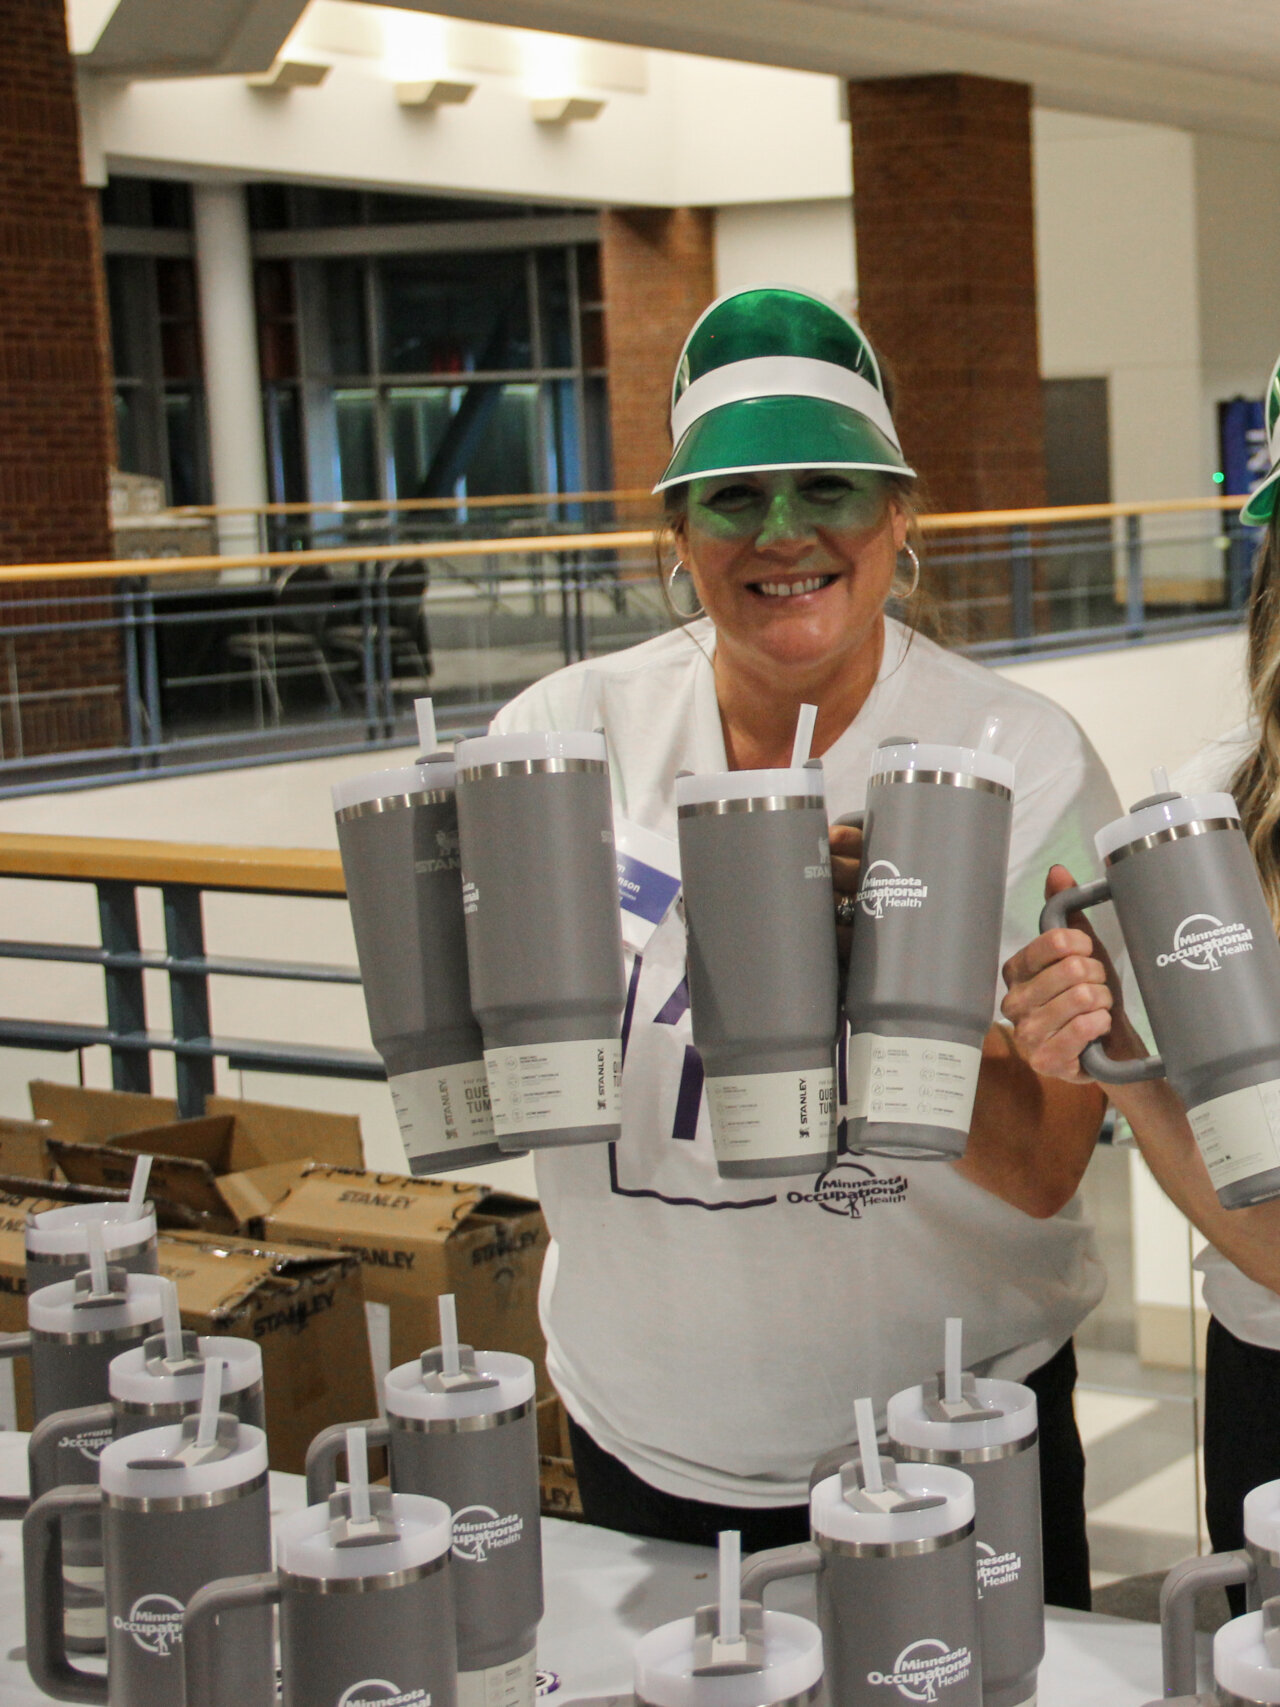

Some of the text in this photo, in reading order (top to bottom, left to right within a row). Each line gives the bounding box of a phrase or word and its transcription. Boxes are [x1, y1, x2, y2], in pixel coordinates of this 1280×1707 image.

[414, 857, 461, 874] STAN
[617, 877, 641, 893] nson
[864, 877, 922, 889] Minnesota
[885, 896, 922, 908] Health
[1179, 922, 1245, 947] Minnesota
[1156, 928, 1253, 967] Occupational
[1217, 941, 1253, 957] Health
[598, 1048, 606, 1096] STANLEY
[799, 1077, 808, 1125] STANLEY
[786, 1178, 908, 1204] Occupational
[821, 1175, 902, 1190] Minnesota
[863, 1194, 906, 1207] Health
[453, 1513, 519, 1534] Minnesota
[453, 1517, 524, 1546] upational
[487, 1533, 521, 1549] Health
[976, 1552, 1017, 1567] nesota
[984, 1571, 1019, 1587] Health
[135, 1610, 184, 1623] Minne
[901, 1646, 968, 1672] Minnesota
[867, 1651, 971, 1686] Occupational
[938, 1667, 970, 1688] Health
